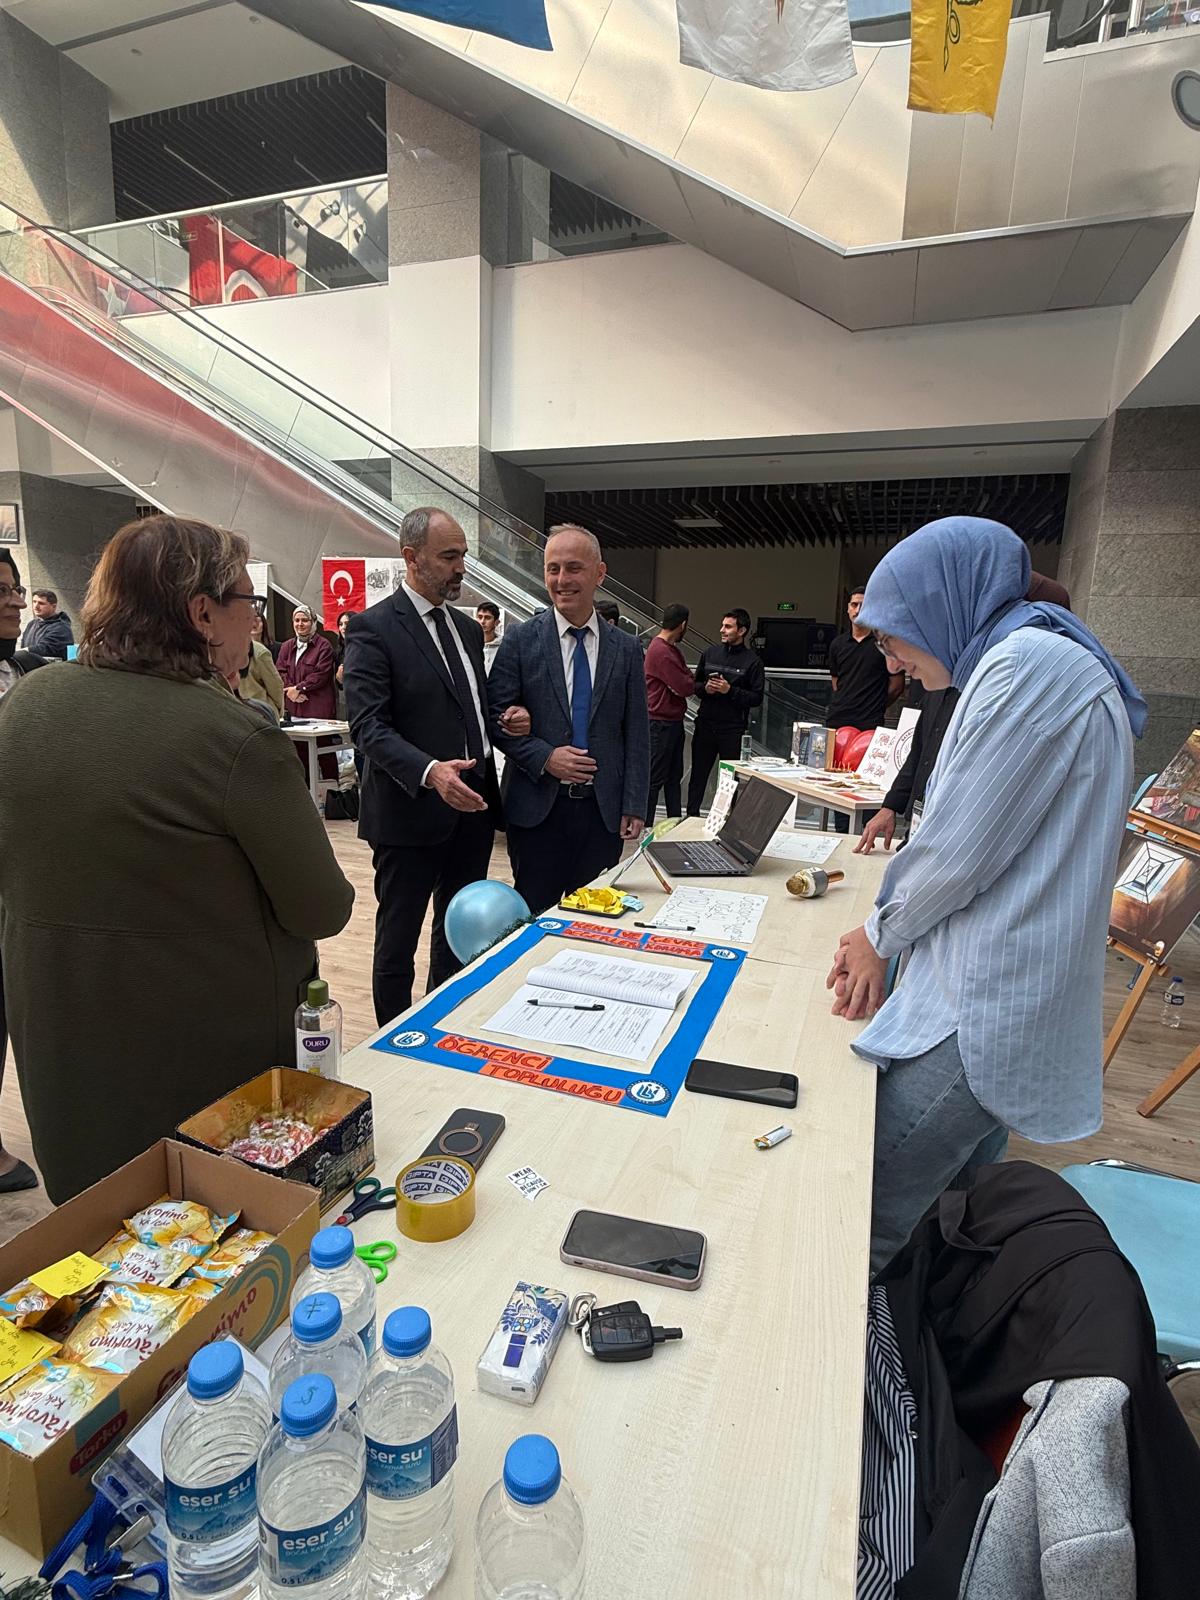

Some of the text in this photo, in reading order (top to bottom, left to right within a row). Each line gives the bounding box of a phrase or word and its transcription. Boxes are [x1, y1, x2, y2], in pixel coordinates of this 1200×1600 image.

[305, 1039, 328, 1047] DURU
[513, 1167, 533, 1178] WEAR
[76, 1418, 124, 1466] Torku
[400, 1449, 423, 1464] su
[179, 1492, 223, 1508] eser
[228, 1476, 251, 1499] su
[282, 1510, 355, 1551] eser su
